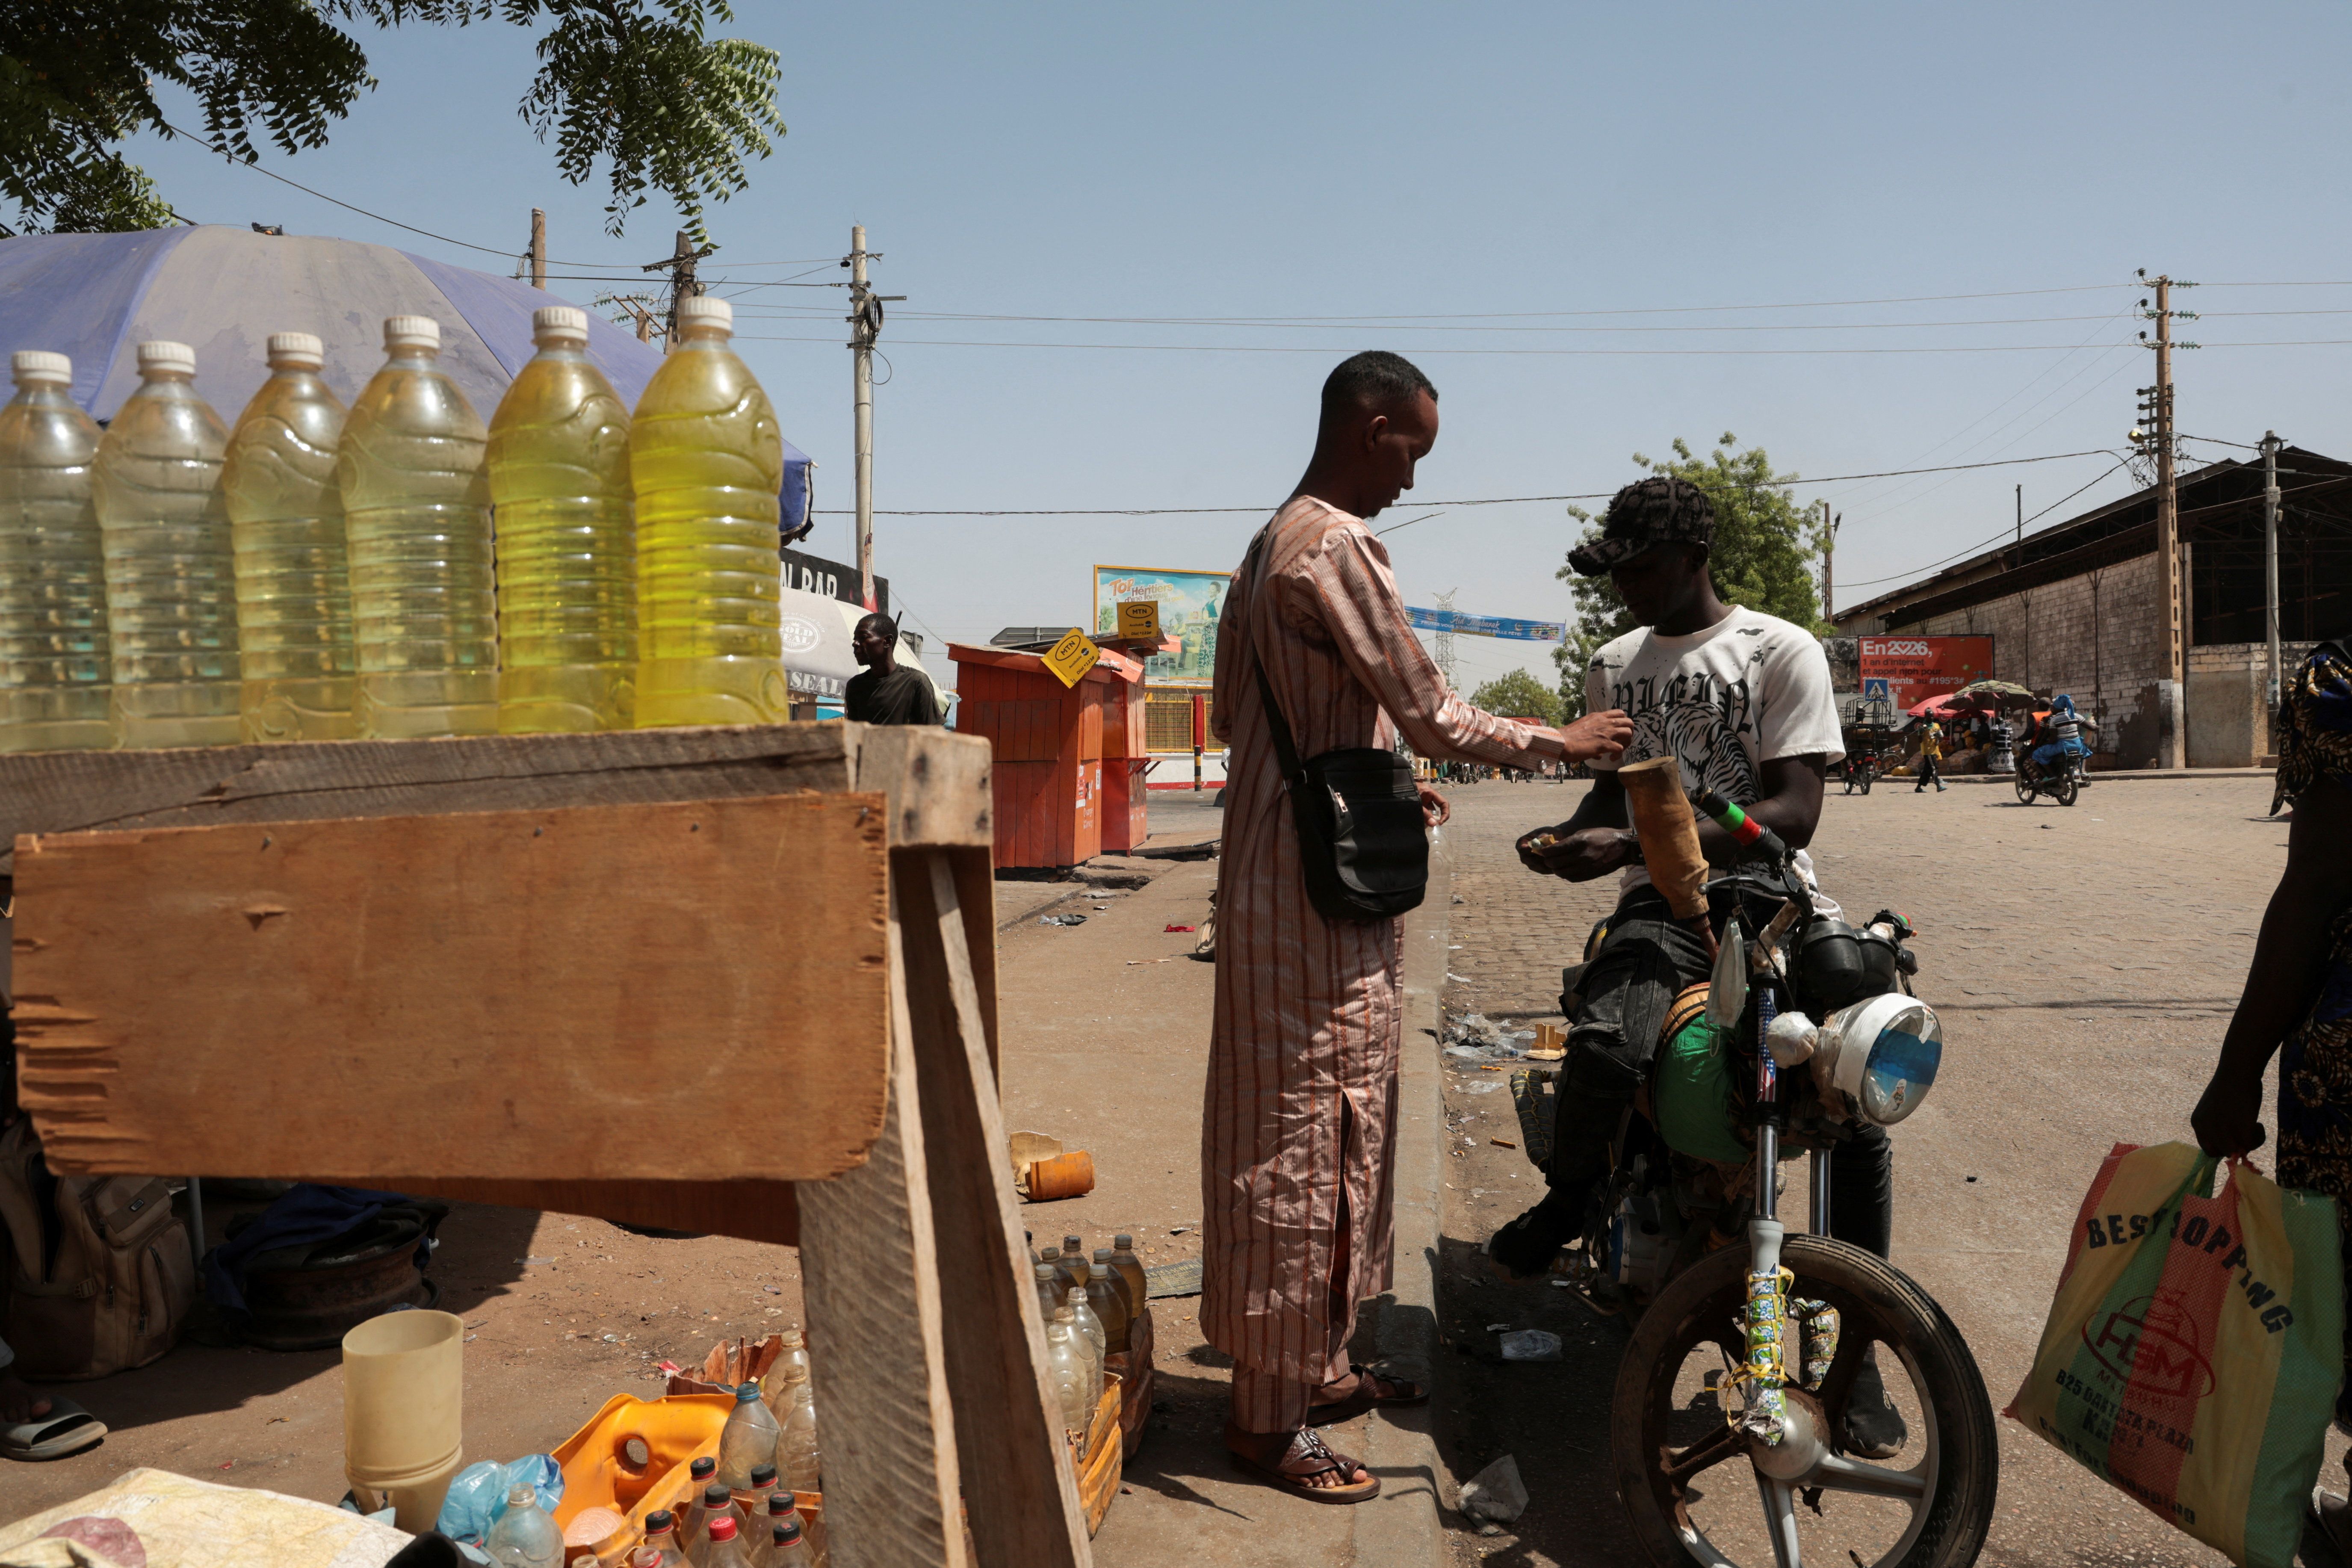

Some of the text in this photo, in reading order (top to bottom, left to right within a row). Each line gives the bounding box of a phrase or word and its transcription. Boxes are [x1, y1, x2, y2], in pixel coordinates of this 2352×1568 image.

[1109, 578, 1134, 596] TOP
[1132, 584, 1173, 596] Héritiers
[1450, 614, 1500, 630] Aid Mubarak
[780, 633, 810, 644] EAL
[1061, 641, 1076, 656] MTN
[1863, 641, 1886, 655] En
[1069, 656, 1082, 669] Available
[1076, 667, 1084, 675] Dial
[1873, 668, 1897, 677] appel
[1900, 668, 1918, 677] njoh
[790, 672, 842, 696] SEAL
[2055, 1369, 2083, 1396] B25
[2146, 1418, 2194, 1455] PLAZA
